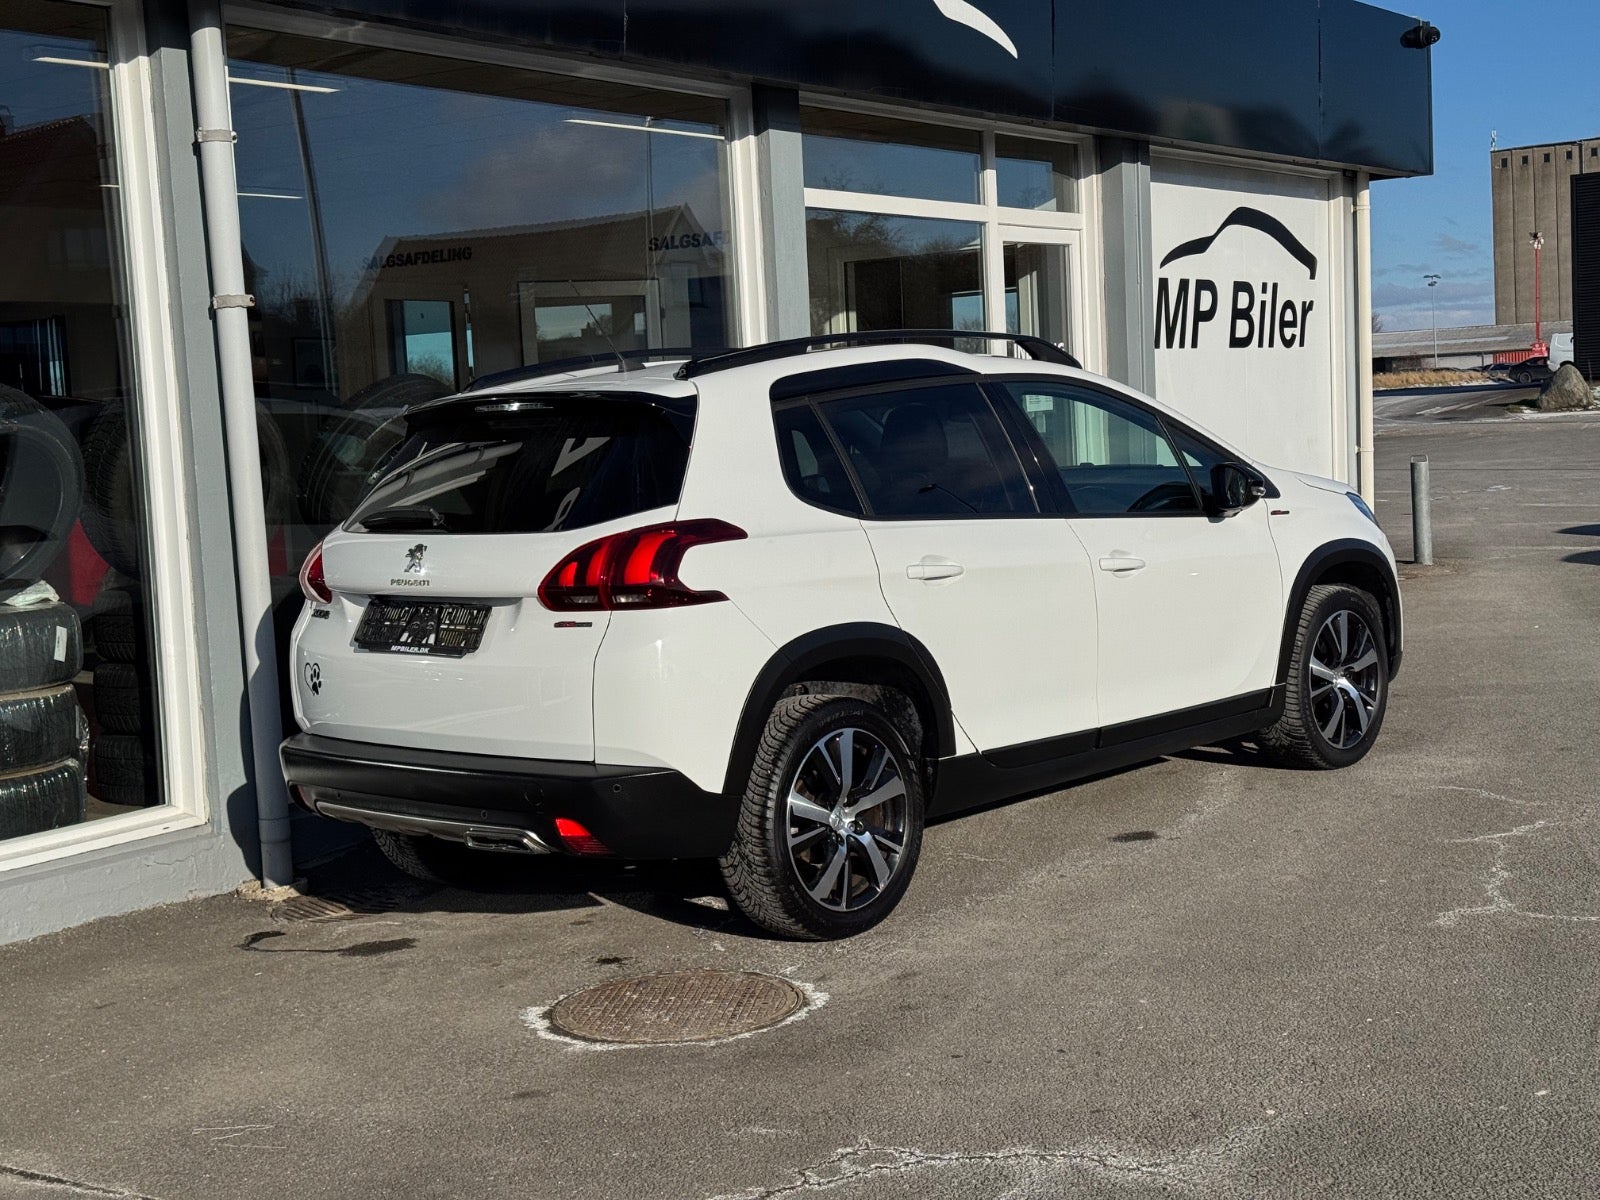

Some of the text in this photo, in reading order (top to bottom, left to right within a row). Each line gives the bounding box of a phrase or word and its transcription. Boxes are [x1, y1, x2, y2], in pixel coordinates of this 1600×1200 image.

[362, 246, 473, 270] SALGSAFDELING
[1154, 277, 1314, 349] MP Biler
[390, 578, 430, 586] PEUGEOT
[390, 645, 430, 654] MPBILER.DK
